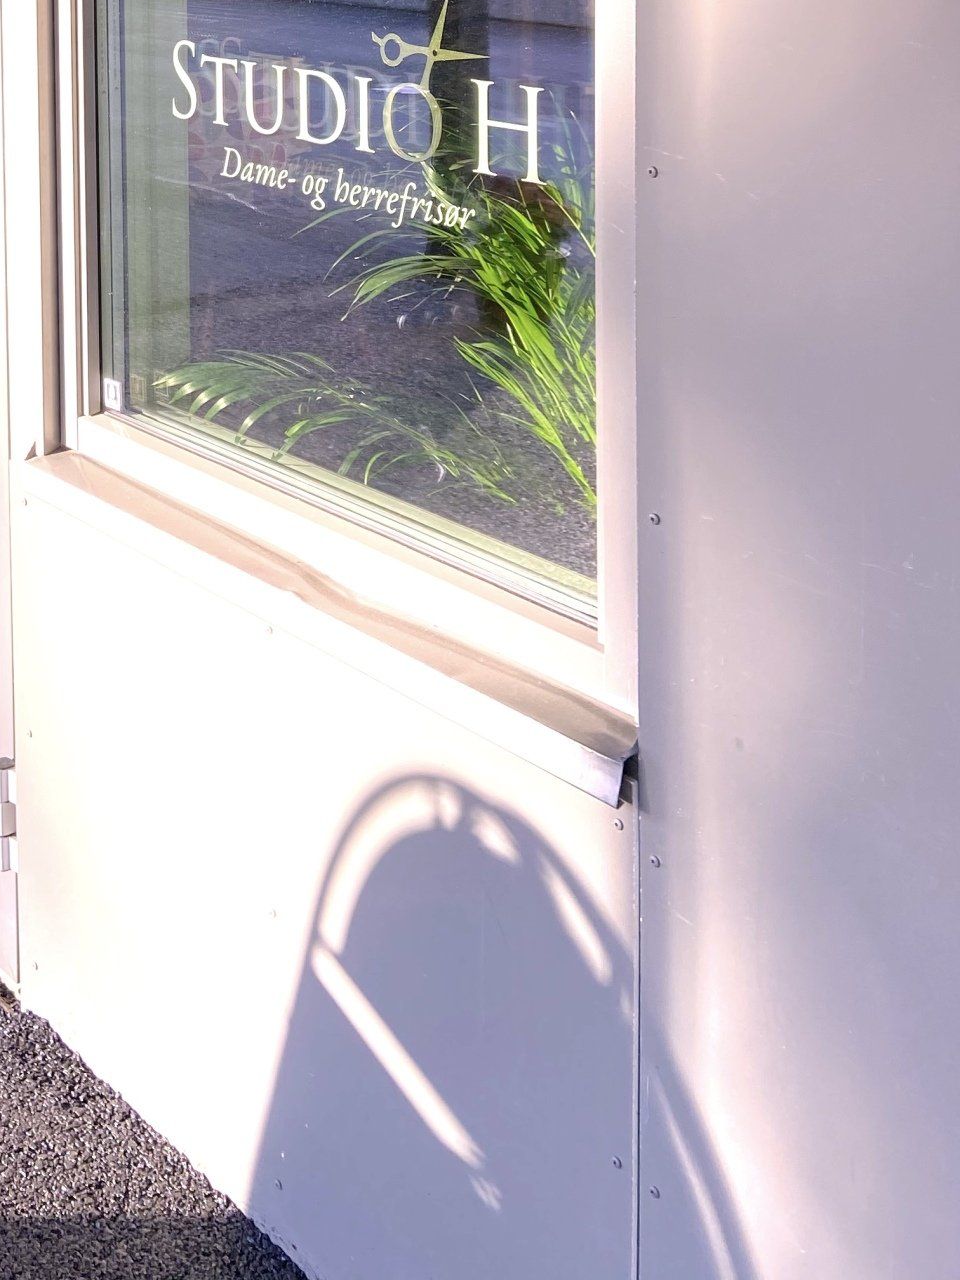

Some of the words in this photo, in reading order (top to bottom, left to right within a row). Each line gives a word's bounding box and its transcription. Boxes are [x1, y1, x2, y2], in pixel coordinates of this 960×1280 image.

[470, 78, 548, 186] H
[220, 146, 296, 190] Dame-
[302, 173, 329, 211] og
[334, 167, 476, 229] herrefrisør
